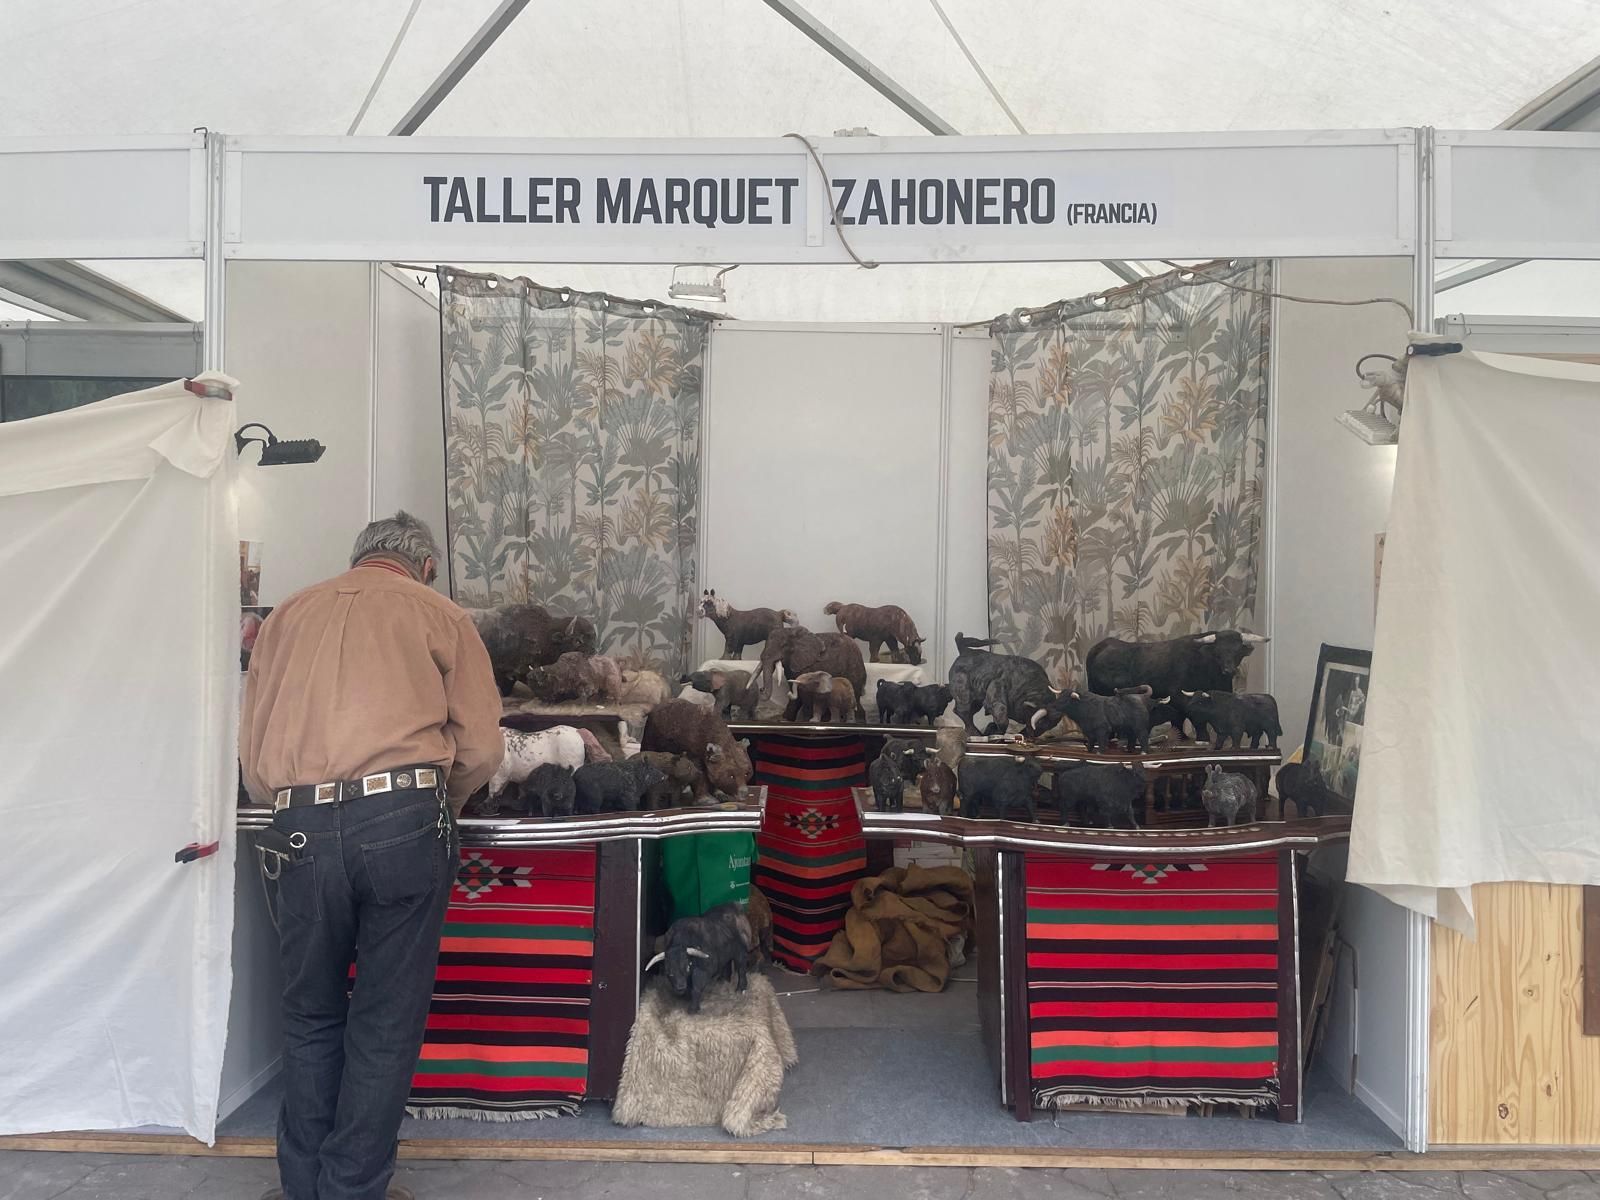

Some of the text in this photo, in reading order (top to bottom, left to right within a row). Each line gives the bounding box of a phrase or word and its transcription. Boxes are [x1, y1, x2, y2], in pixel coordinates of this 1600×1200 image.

[423, 176, 1158, 229] TALLER MARQUET ZAHONERO (FRANCIA)
